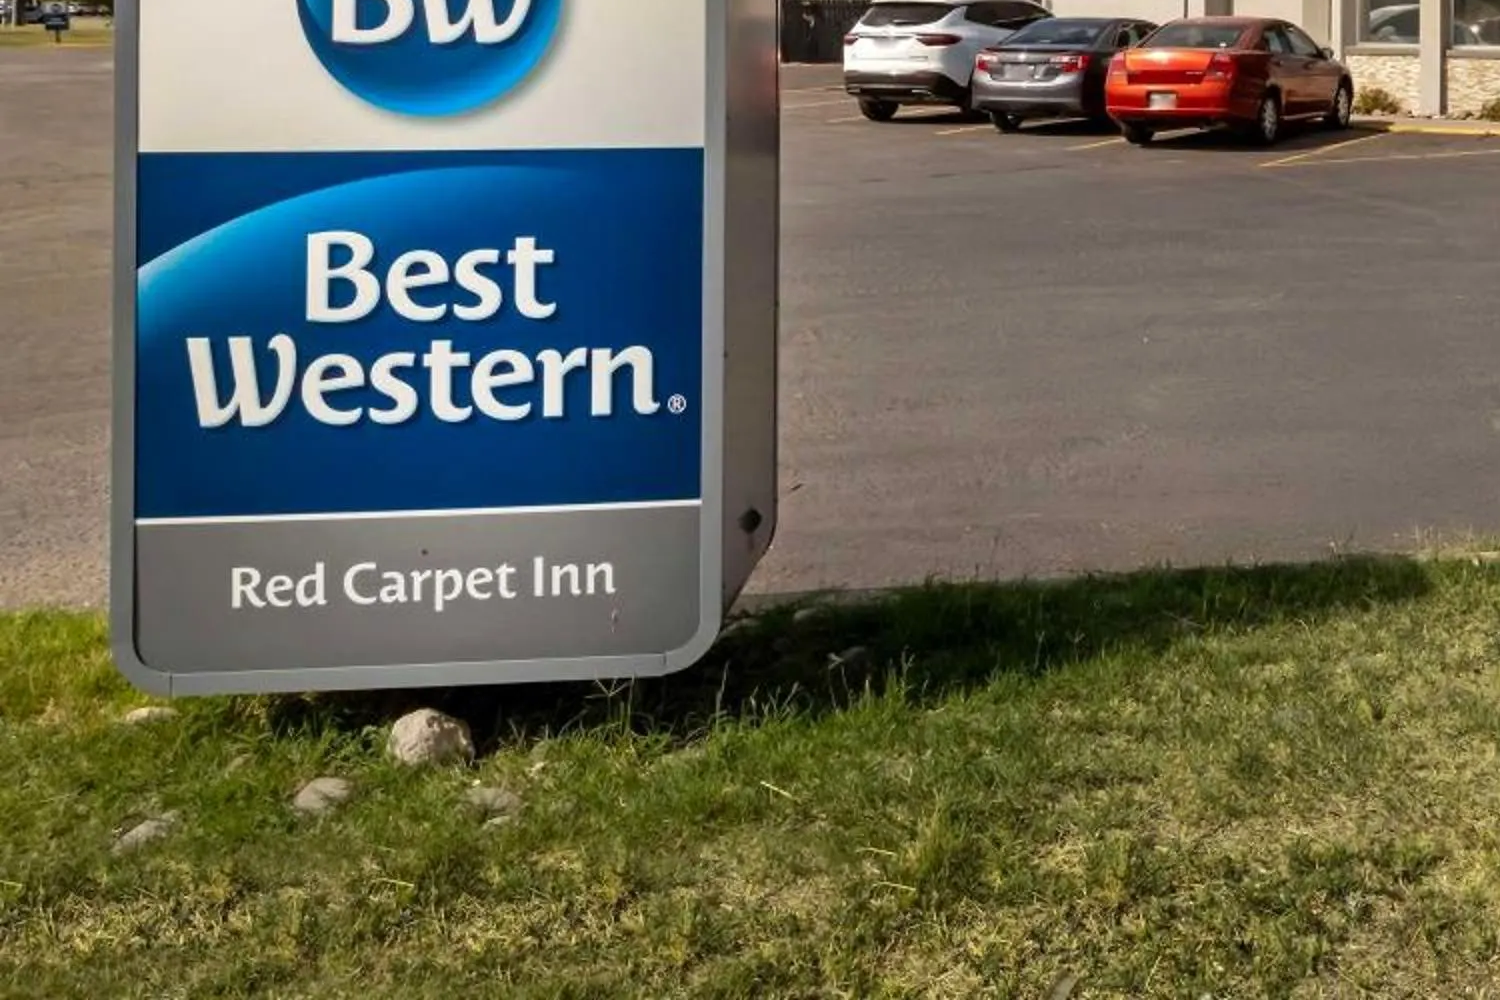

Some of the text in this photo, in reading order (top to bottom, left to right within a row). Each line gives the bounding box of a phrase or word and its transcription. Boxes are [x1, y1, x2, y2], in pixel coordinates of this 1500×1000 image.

[305, 229, 558, 323] Best
[230, 554, 617, 613] Red Carpet Inn
